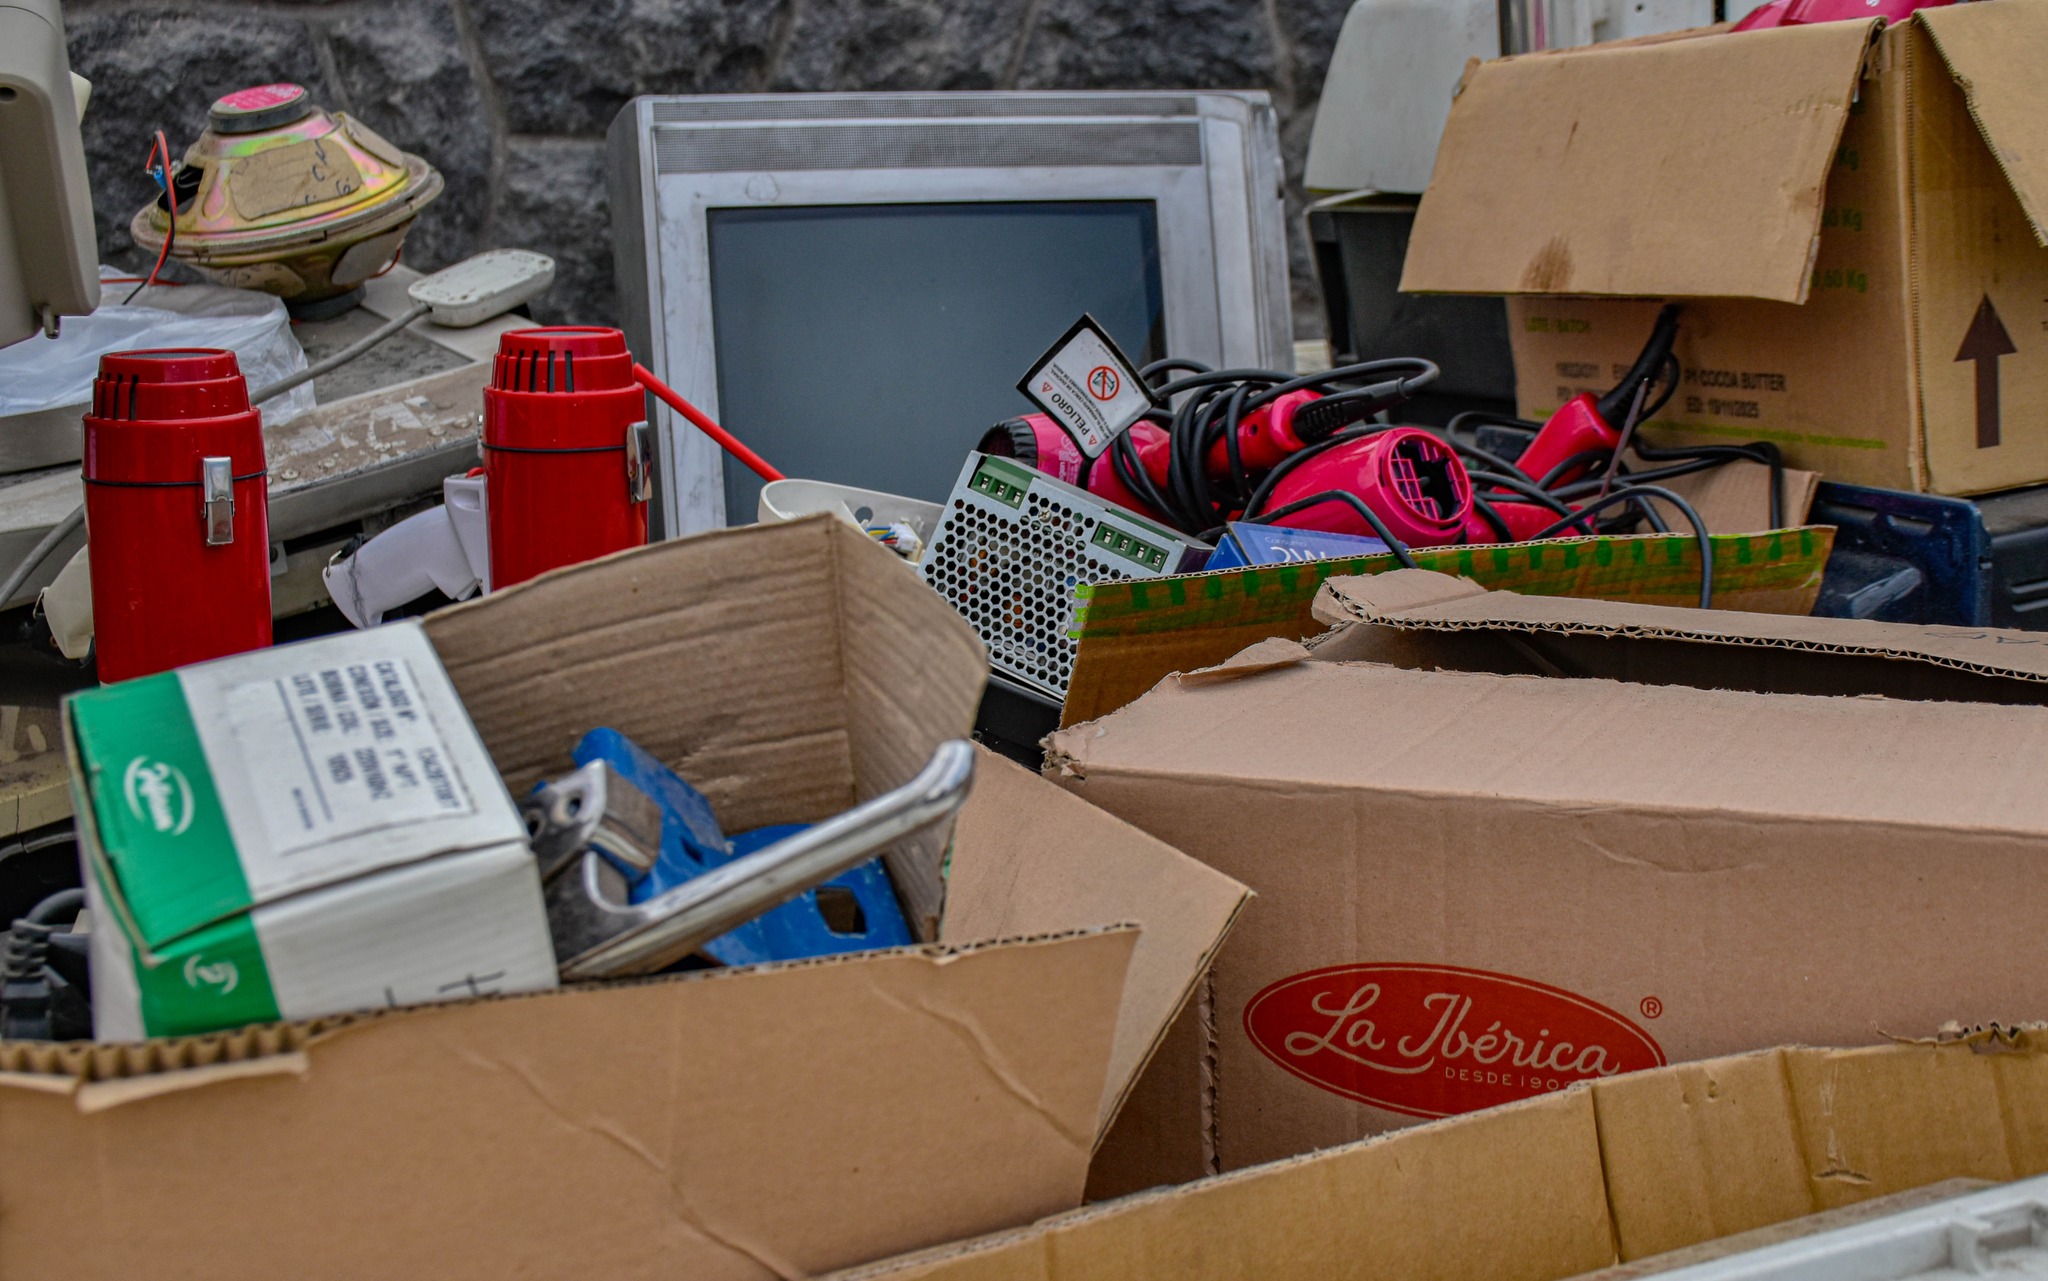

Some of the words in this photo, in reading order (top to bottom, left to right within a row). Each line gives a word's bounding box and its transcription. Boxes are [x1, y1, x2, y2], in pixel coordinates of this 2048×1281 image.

[1842, 208, 1863, 232] Kg
[1846, 270, 1868, 293] Kg
[1700, 369, 1737, 388] COCOA
[1740, 372, 1785, 392] BUTTER
[1051, 393, 1090, 436] PELIGRO
[1284, 983, 1435, 1075] La
[1397, 992, 1621, 1077] Ibérica
[1445, 1067, 1513, 1087] DESDE
